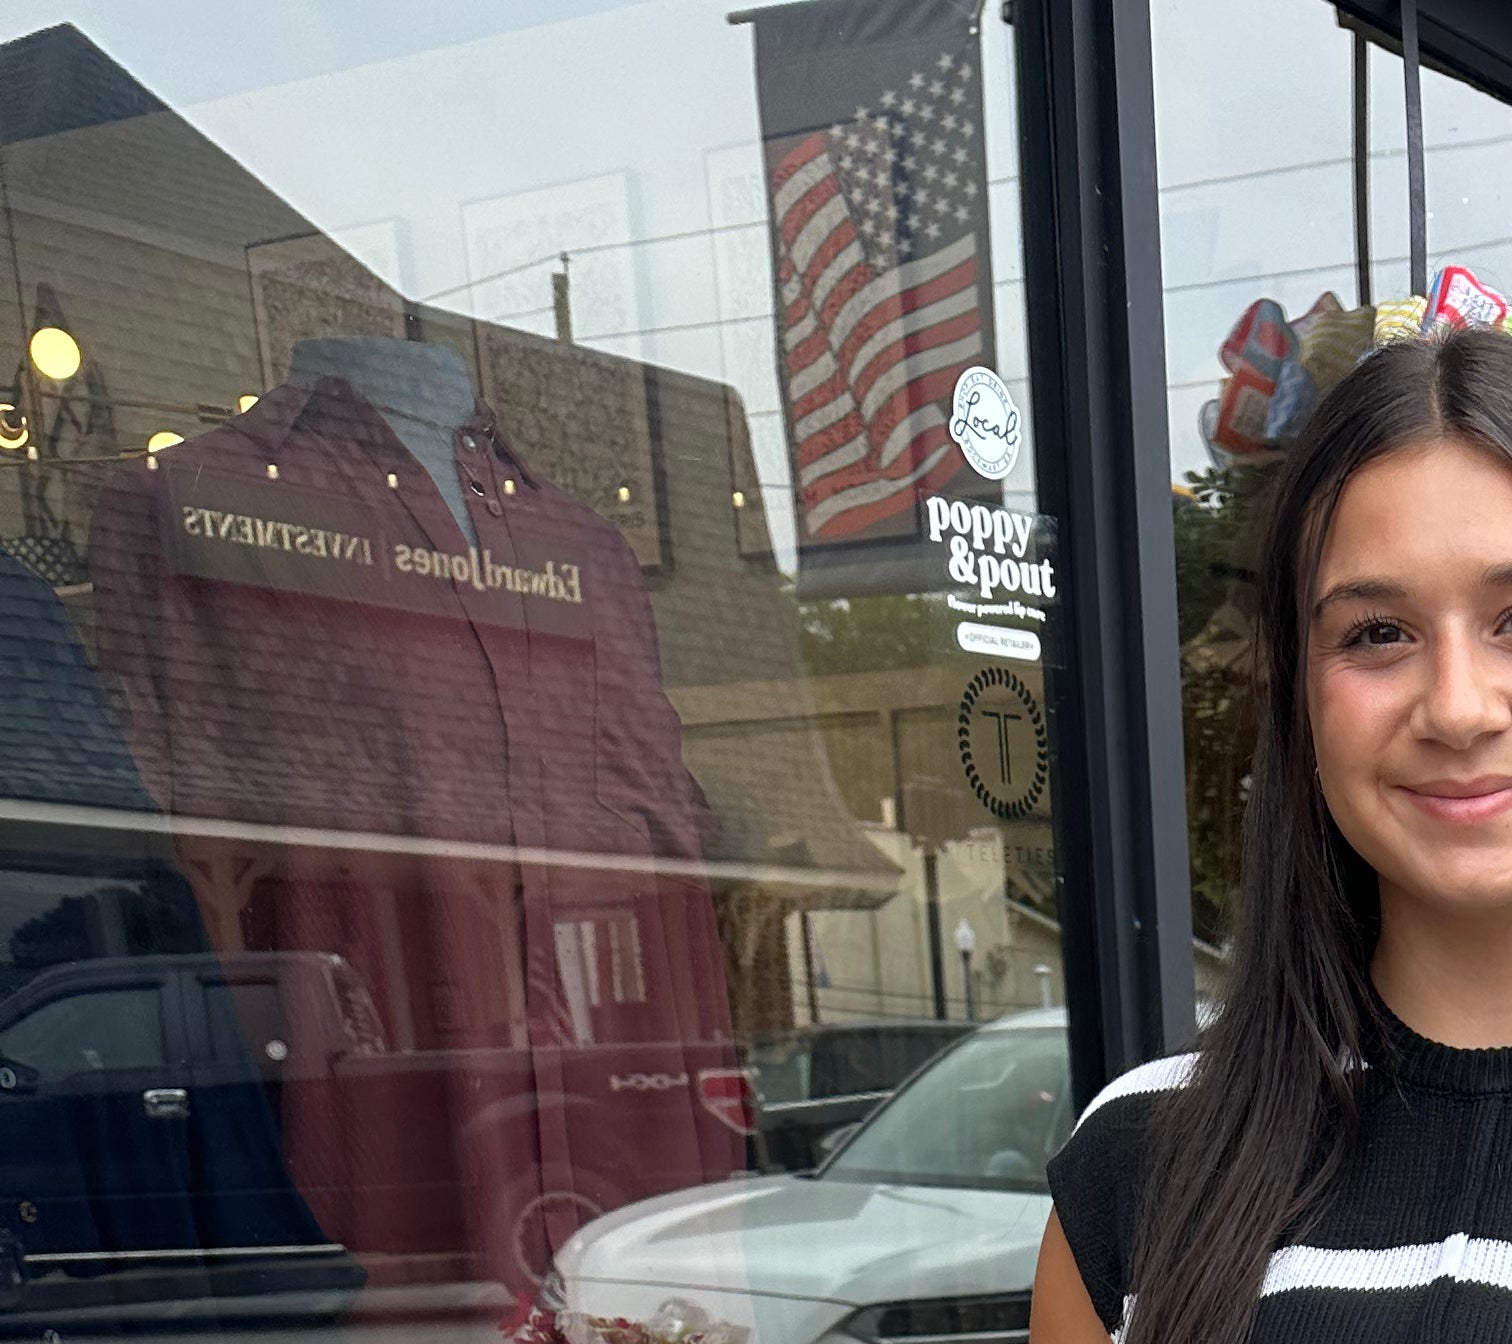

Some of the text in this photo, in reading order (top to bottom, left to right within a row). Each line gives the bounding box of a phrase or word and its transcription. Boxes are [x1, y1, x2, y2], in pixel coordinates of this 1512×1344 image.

[954, 391, 1018, 445] Local
[926, 496, 1033, 558] poppy
[949, 535, 1056, 598] &pout
